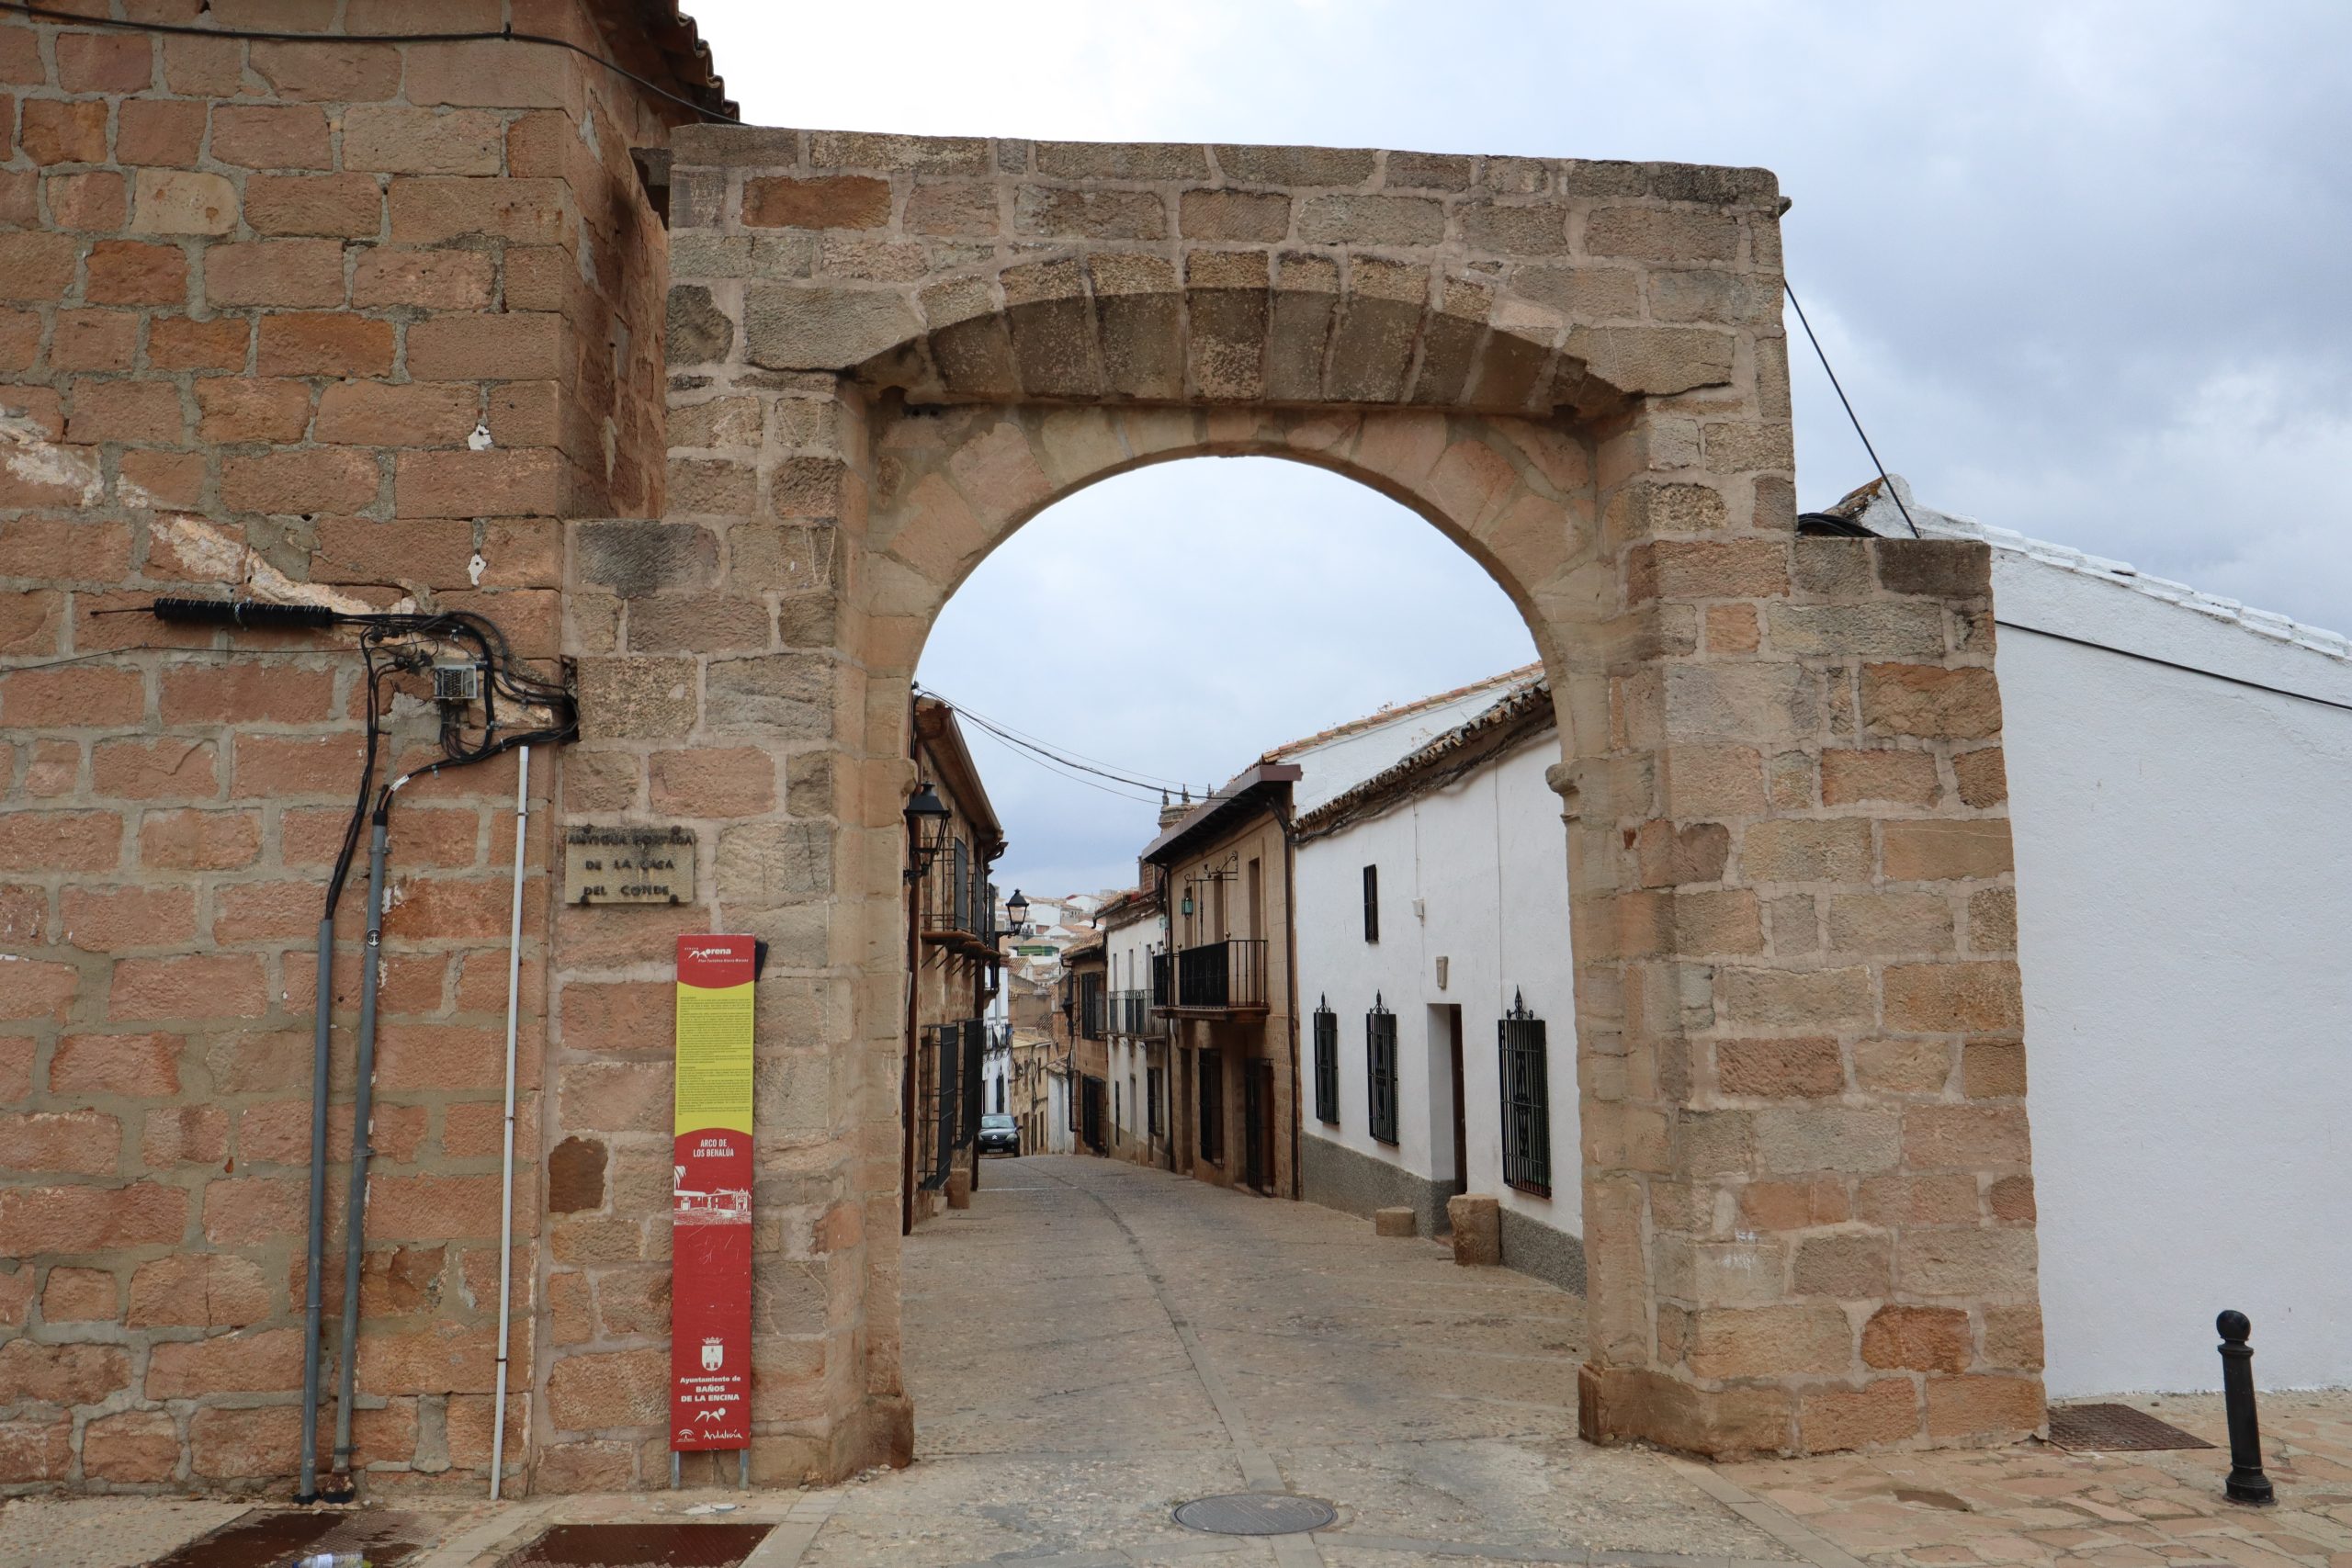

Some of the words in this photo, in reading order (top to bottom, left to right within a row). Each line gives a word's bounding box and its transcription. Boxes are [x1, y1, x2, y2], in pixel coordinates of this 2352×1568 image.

[585, 860, 602, 870] DE
[614, 859, 632, 870] LA
[639, 859, 674, 870] CASA
[583, 886, 606, 896] DEL
[620, 886, 670, 896] CONDE
[700, 1139, 717, 1147] ARCO
[718, 1139, 728, 1147] DE
[693, 1149, 705, 1157] LOS
[706, 1146, 734, 1157] BENALÚA
[680, 1376, 730, 1384] Ayuntamiento
[695, 1384, 726, 1393] BAÑOS
[707, 1393, 740, 1402] ENCINA
